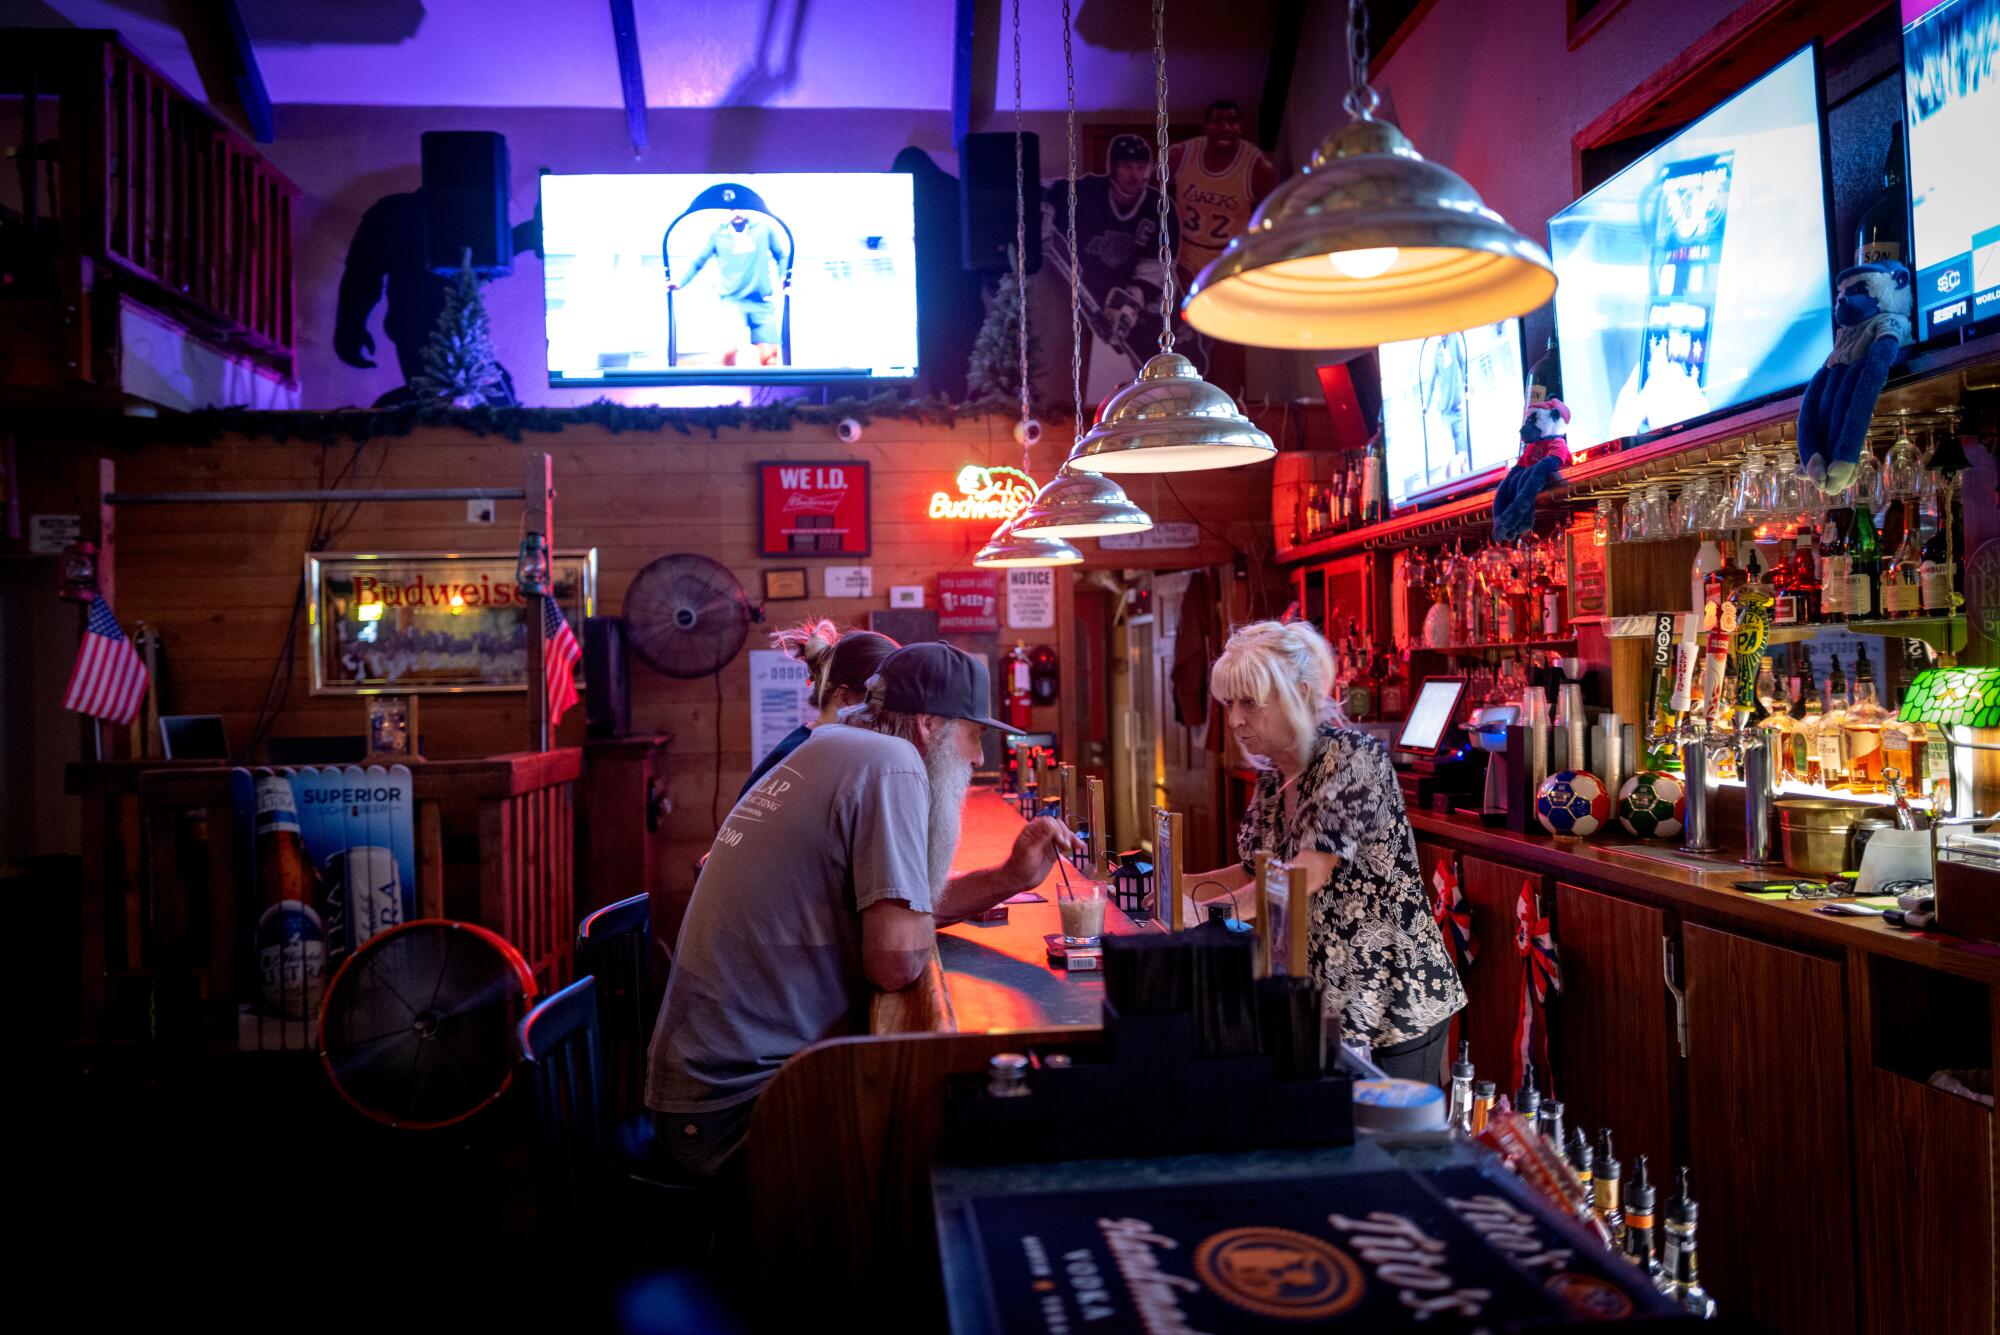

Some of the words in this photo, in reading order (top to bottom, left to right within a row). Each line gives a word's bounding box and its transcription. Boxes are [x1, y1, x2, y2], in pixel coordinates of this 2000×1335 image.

[1183, 204, 1230, 238] 32
[1933, 300, 1967, 325] ESPN
[779, 467, 811, 490] WE
[816, 467, 849, 490] I.D.
[1011, 571, 1050, 585] NOTICE
[1655, 615, 1671, 662] 805
[303, 787, 401, 804] SUPERIOR
[1327, 1211, 1493, 1323] Tito's
[1061, 1248, 1118, 1320] VODKA
